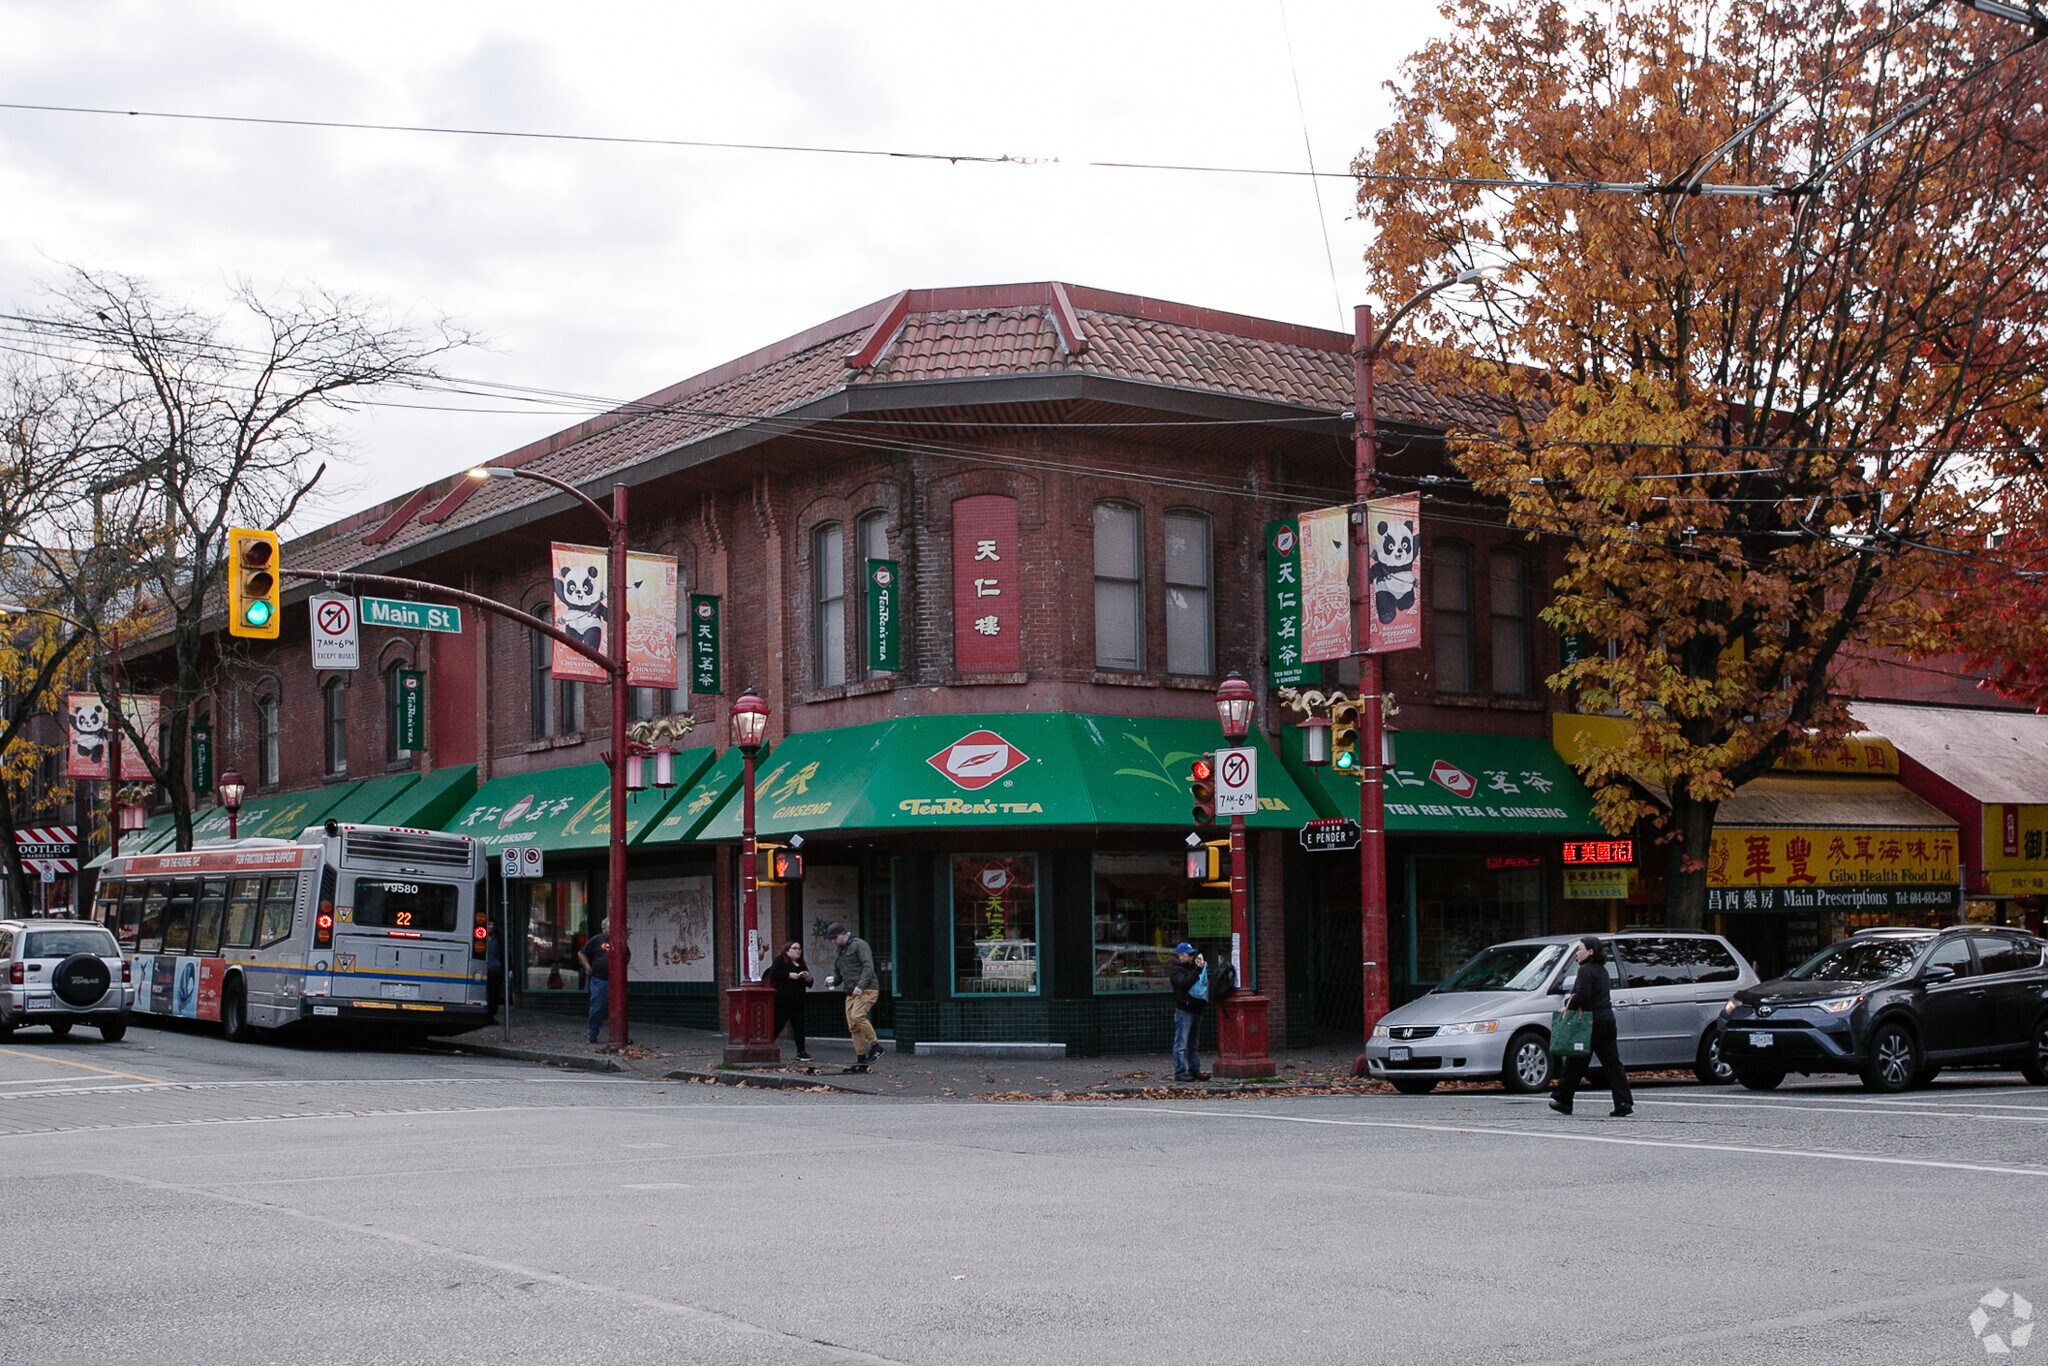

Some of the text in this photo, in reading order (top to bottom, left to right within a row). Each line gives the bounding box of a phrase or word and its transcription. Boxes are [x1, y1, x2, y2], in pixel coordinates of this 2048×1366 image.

[974, 540, 1000, 635] 天仁樓
[372, 602, 450, 627] Main St
[1277, 562, 1297, 665] 天仁茗茶
[698, 625, 714, 686] 天仁茗茶
[632, 666, 671, 674] CHINATOWN
[1483, 770, 1553, 794] 茗茶
[460, 806, 502, 826] 天仁
[525, 796, 574, 822] 茗茶
[772, 802, 832, 819] GINSENG
[999, 802, 1043, 813] TEA
[1384, 803, 1568, 819] TEN REN TEA & GINSENG
[498, 832, 537, 844] GINSENG
[1307, 833, 1313, 844] E
[1316, 832, 1346, 843] PENDER
[18, 844, 71, 854] OOTLEG
[235, 854, 245, 864] FOR
[245, 853, 264, 864] FRICTION
[264, 852, 275, 863] FREE
[275, 851, 297, 862] SUPPORT
[1743, 835, 1953, 884] 華豐 參茸海味行
[1828, 868, 1954, 883] Gibo Health Food Ltd.
[383, 882, 418, 894] V9580
[1708, 889, 1774, 910] 昌西藥房
[1784, 890, 1813, 907] Main
[1817, 888, 1888, 908] Prescriptions
[396, 911, 412, 926] 22
